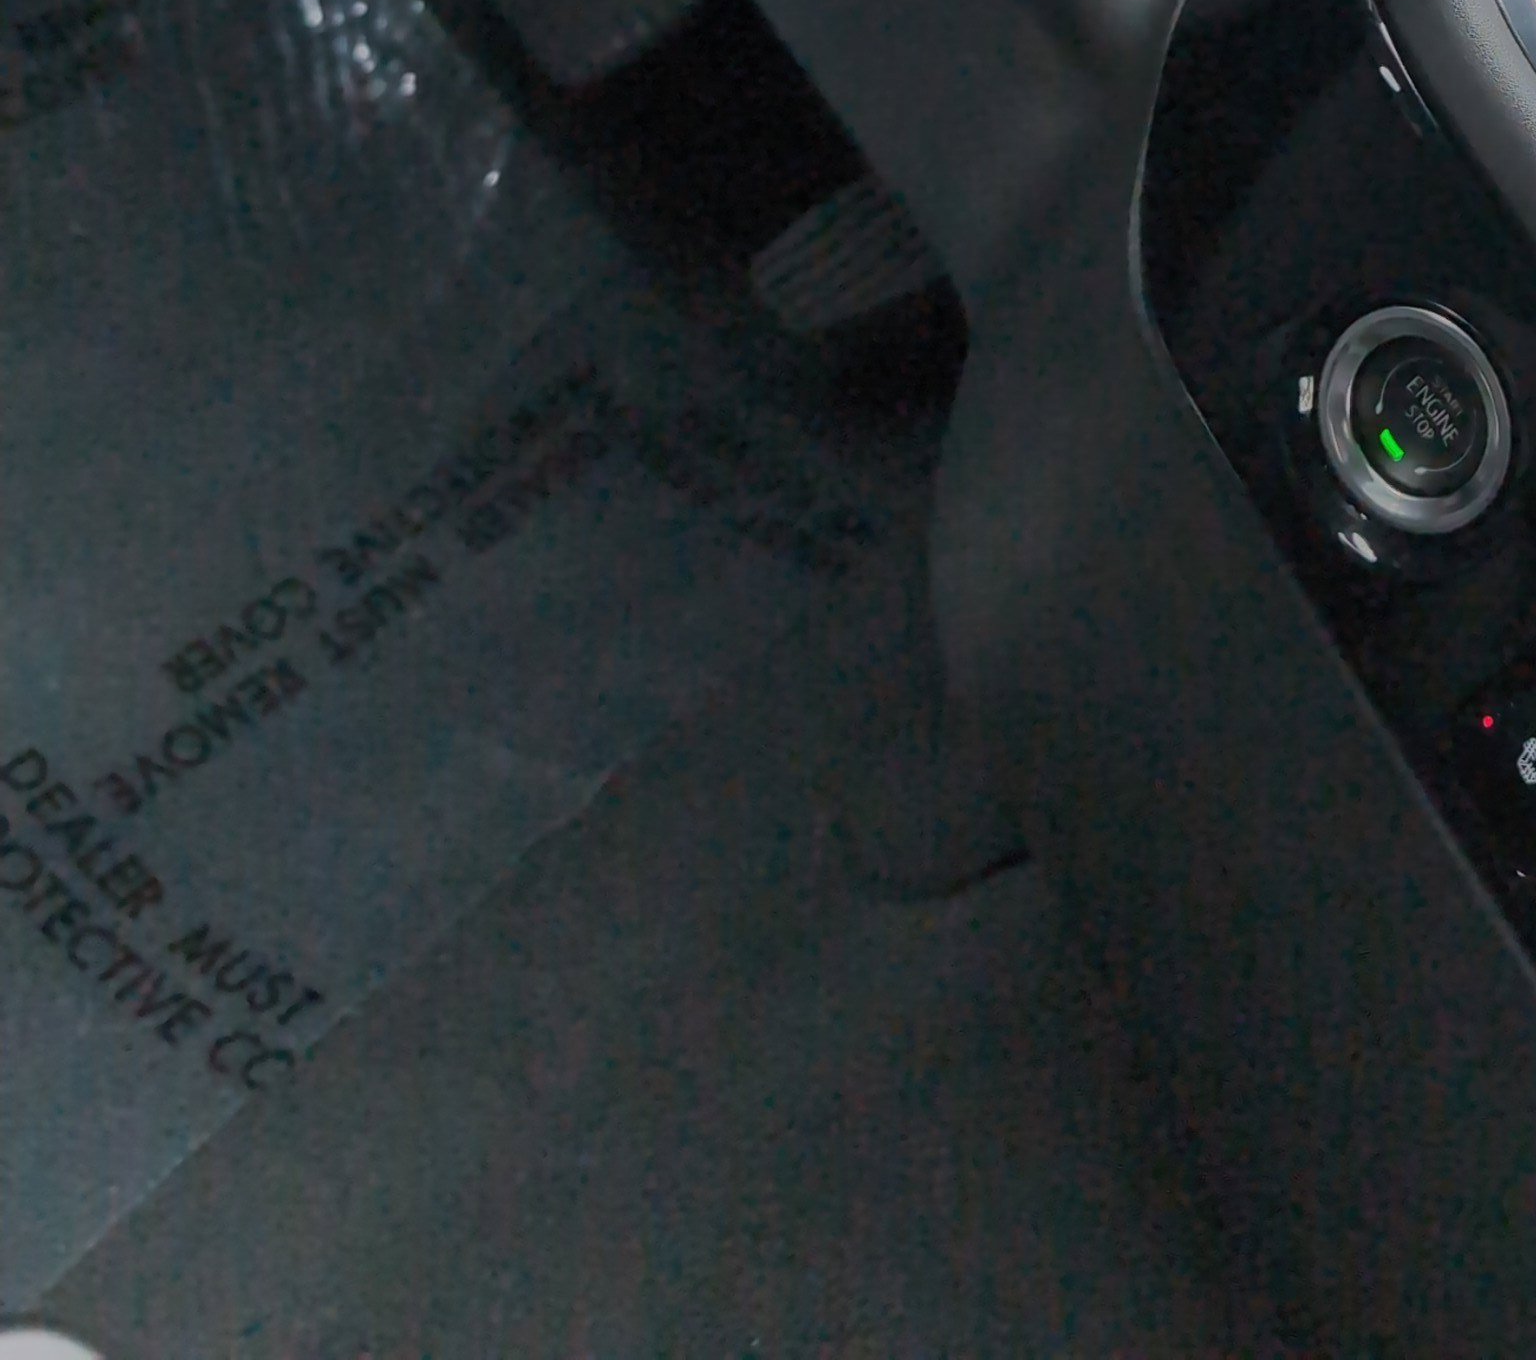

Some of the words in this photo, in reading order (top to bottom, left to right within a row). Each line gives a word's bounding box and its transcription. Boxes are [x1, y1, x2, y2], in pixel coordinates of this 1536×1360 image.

[1405, 375, 1460, 446] ENGINE
[1405, 404, 1434, 441] STOP
[160, 575, 318, 696] COVER
[320, 553, 442, 667] MUST
[95, 656, 309, 818] REMOVE
[0, 747, 166, 920] DEALER
[169, 921, 328, 1025] MUST
